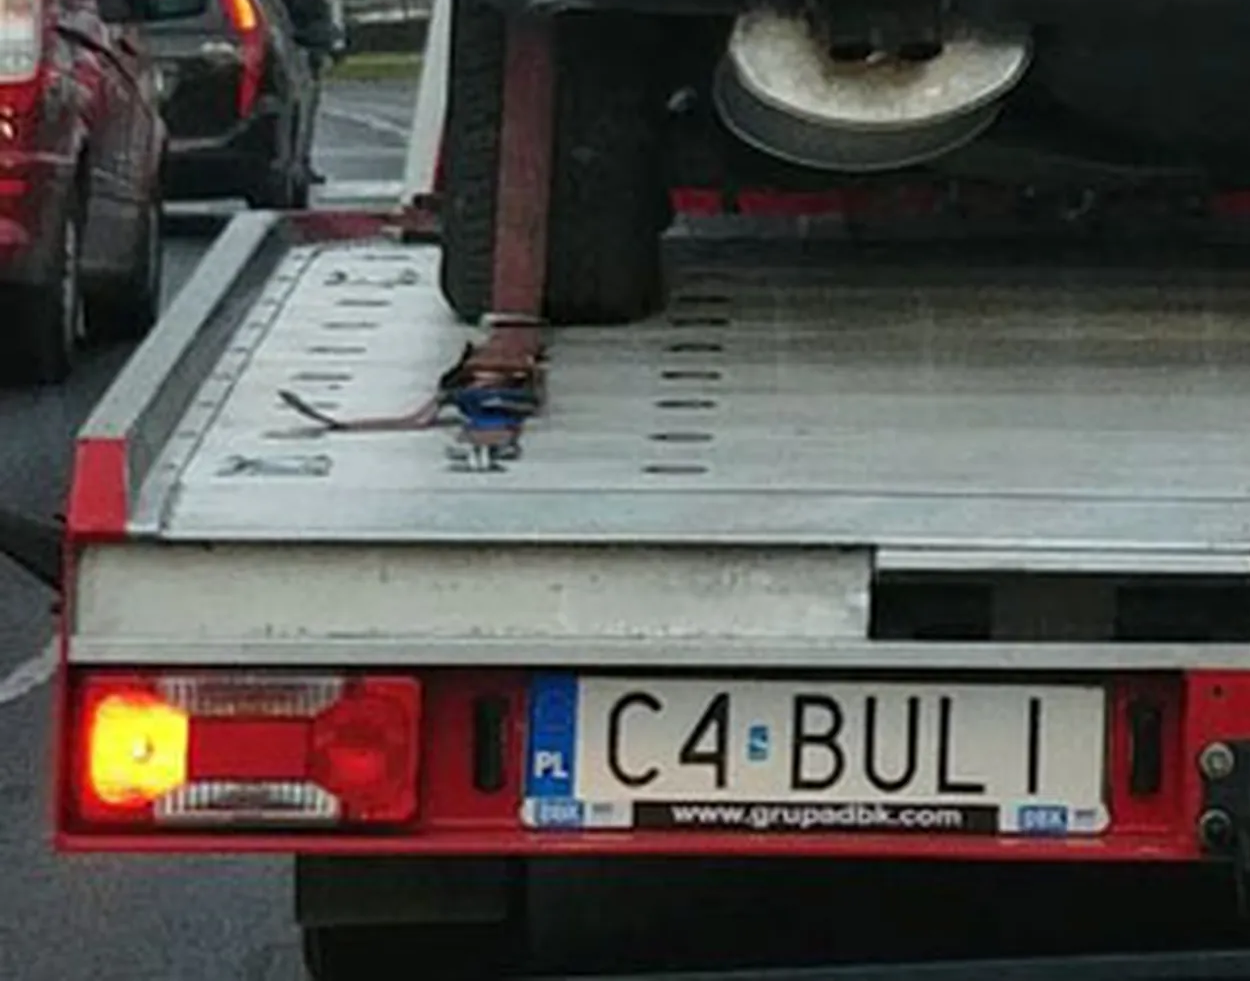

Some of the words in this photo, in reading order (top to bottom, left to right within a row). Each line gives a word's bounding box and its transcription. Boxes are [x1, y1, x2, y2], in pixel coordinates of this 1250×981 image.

[607, 690, 731, 788] C4
[534, 750, 568, 778] PL
[670, 805, 963, 829] www.grupadbk.com
